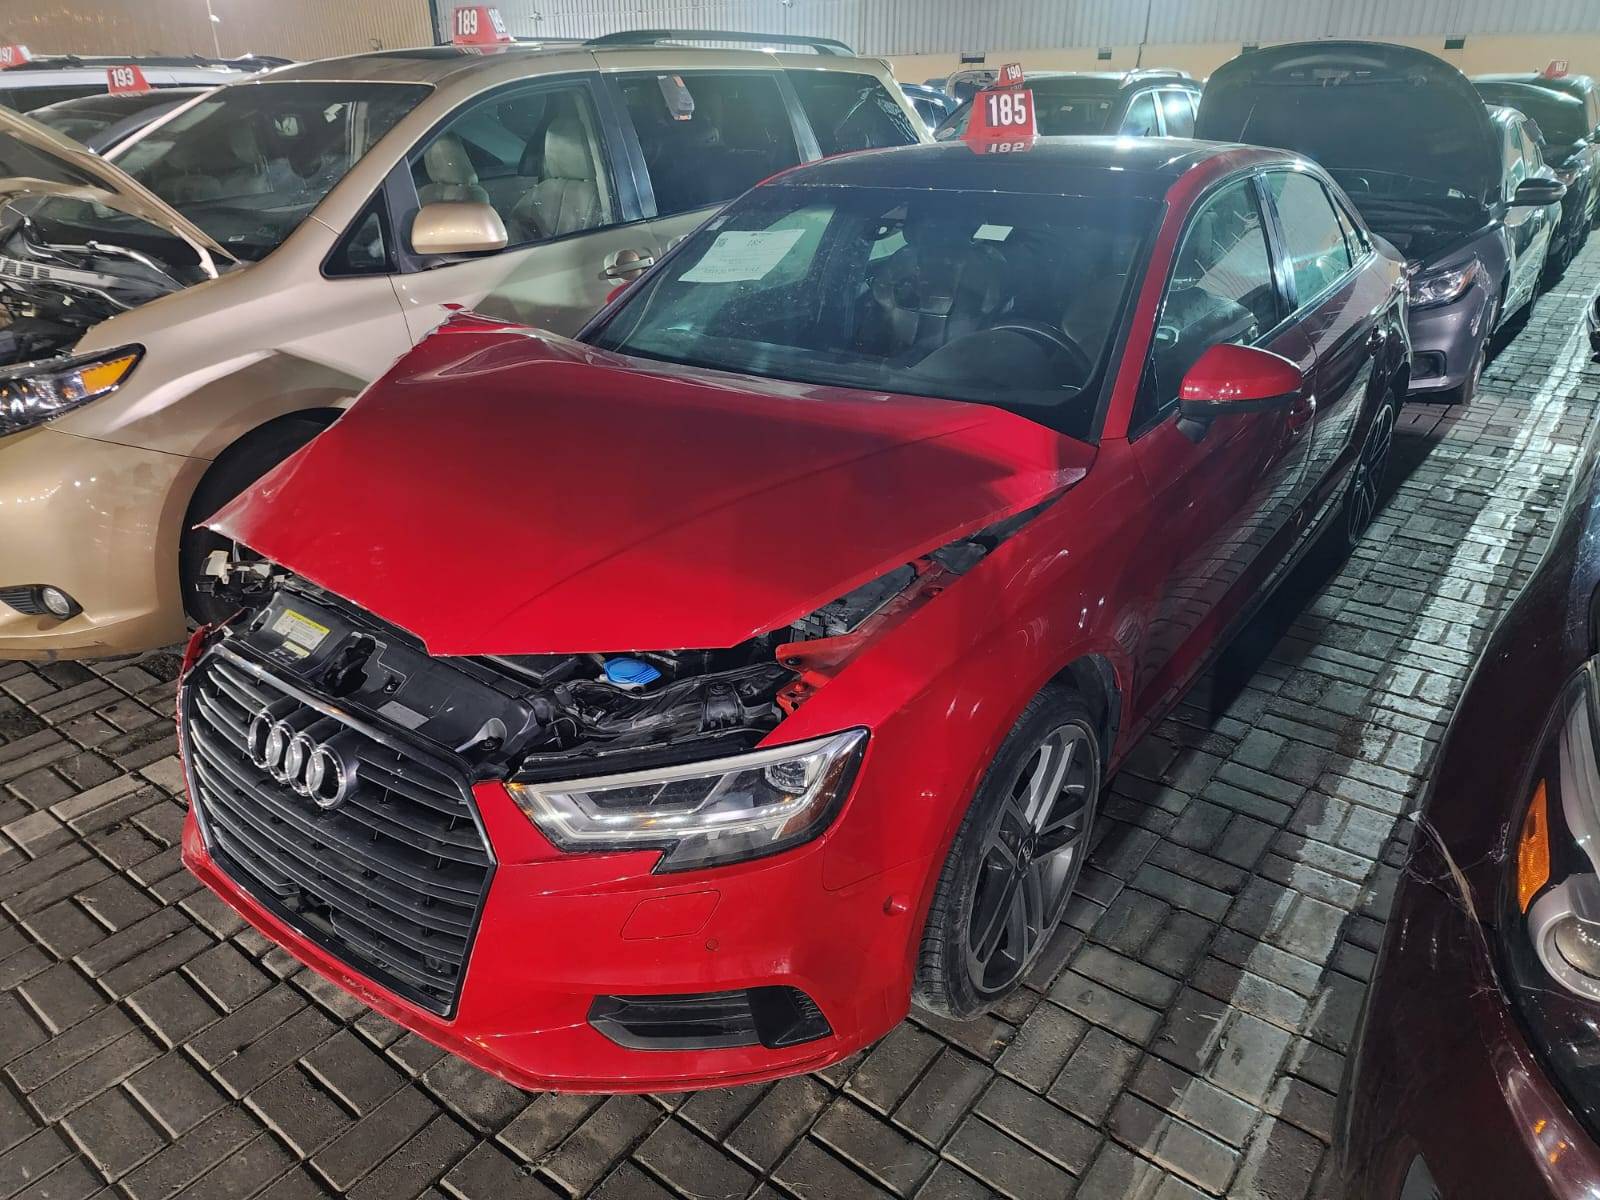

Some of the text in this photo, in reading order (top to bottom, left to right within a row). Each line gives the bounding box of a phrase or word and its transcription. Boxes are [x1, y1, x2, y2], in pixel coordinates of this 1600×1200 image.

[457, 9, 478, 35] 189
[111, 68, 135, 88] 193
[1007, 65, 1021, 80] 190
[989, 93, 1027, 127] 185
